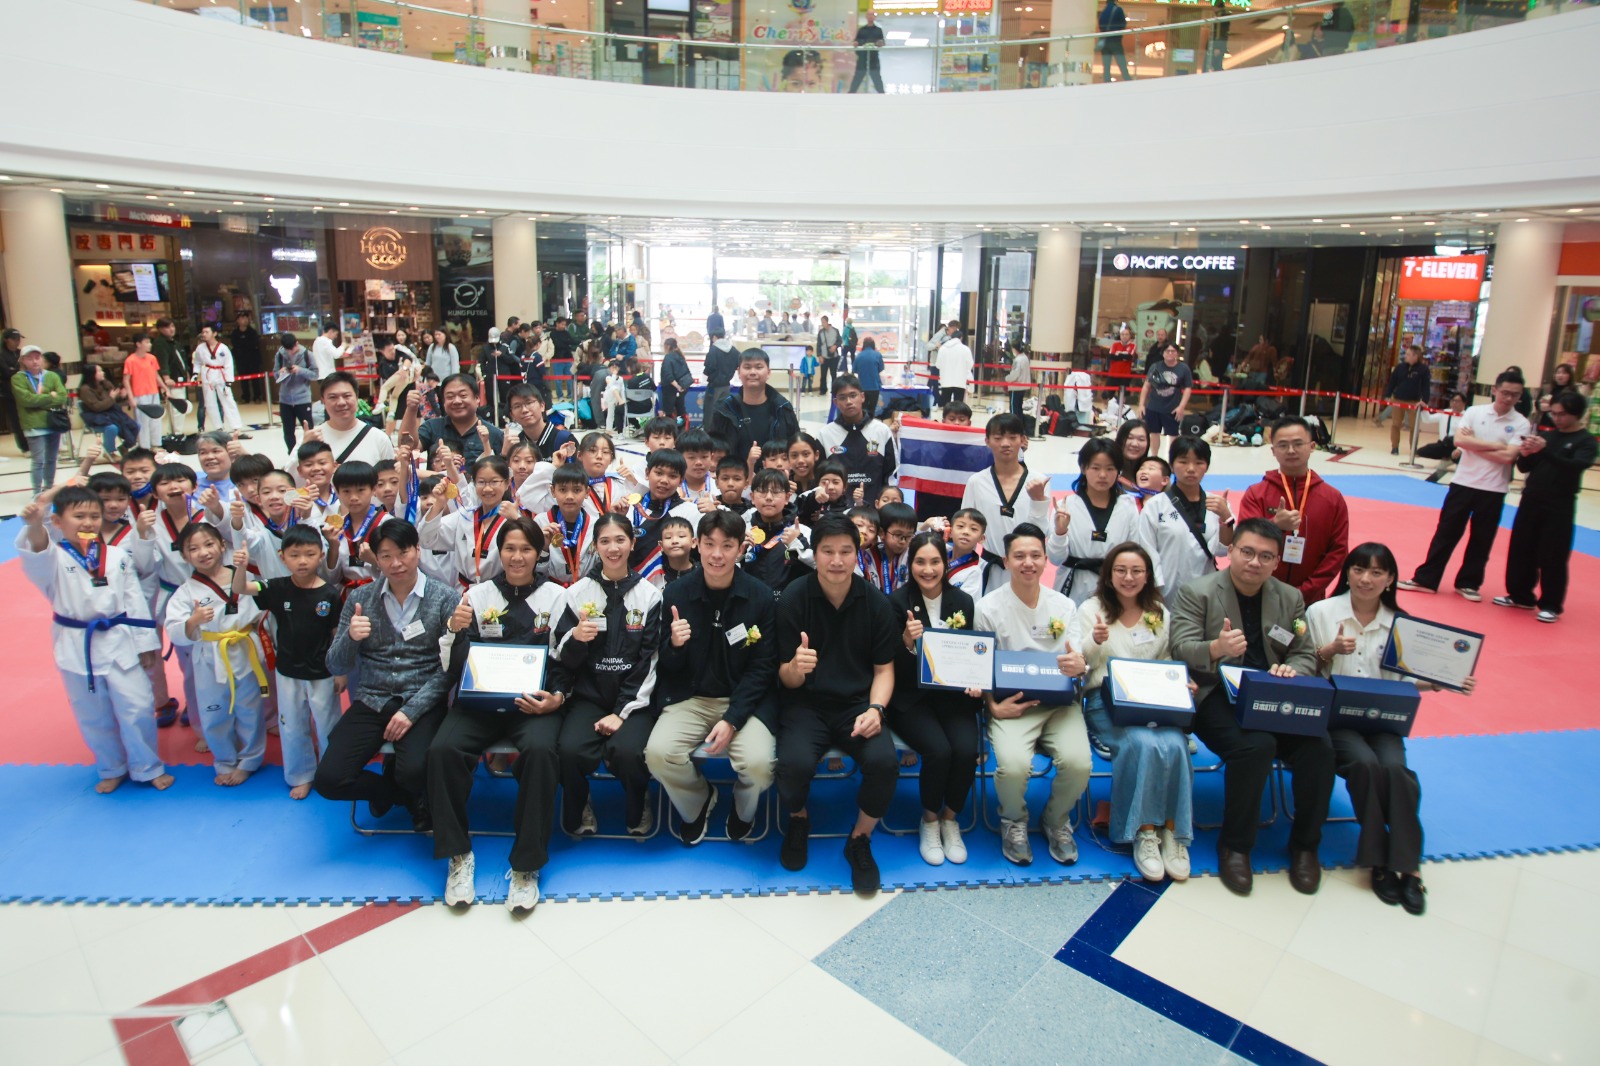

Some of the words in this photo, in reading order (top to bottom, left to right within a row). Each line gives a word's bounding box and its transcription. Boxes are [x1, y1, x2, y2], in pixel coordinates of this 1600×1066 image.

[754, 25, 816, 41] Cherry
[819, 27, 852, 41] Kids
[128, 211, 173, 224] McDonald's
[1130, 255, 1179, 269] PACIFIC
[1182, 256, 1235, 270] COFFEE
